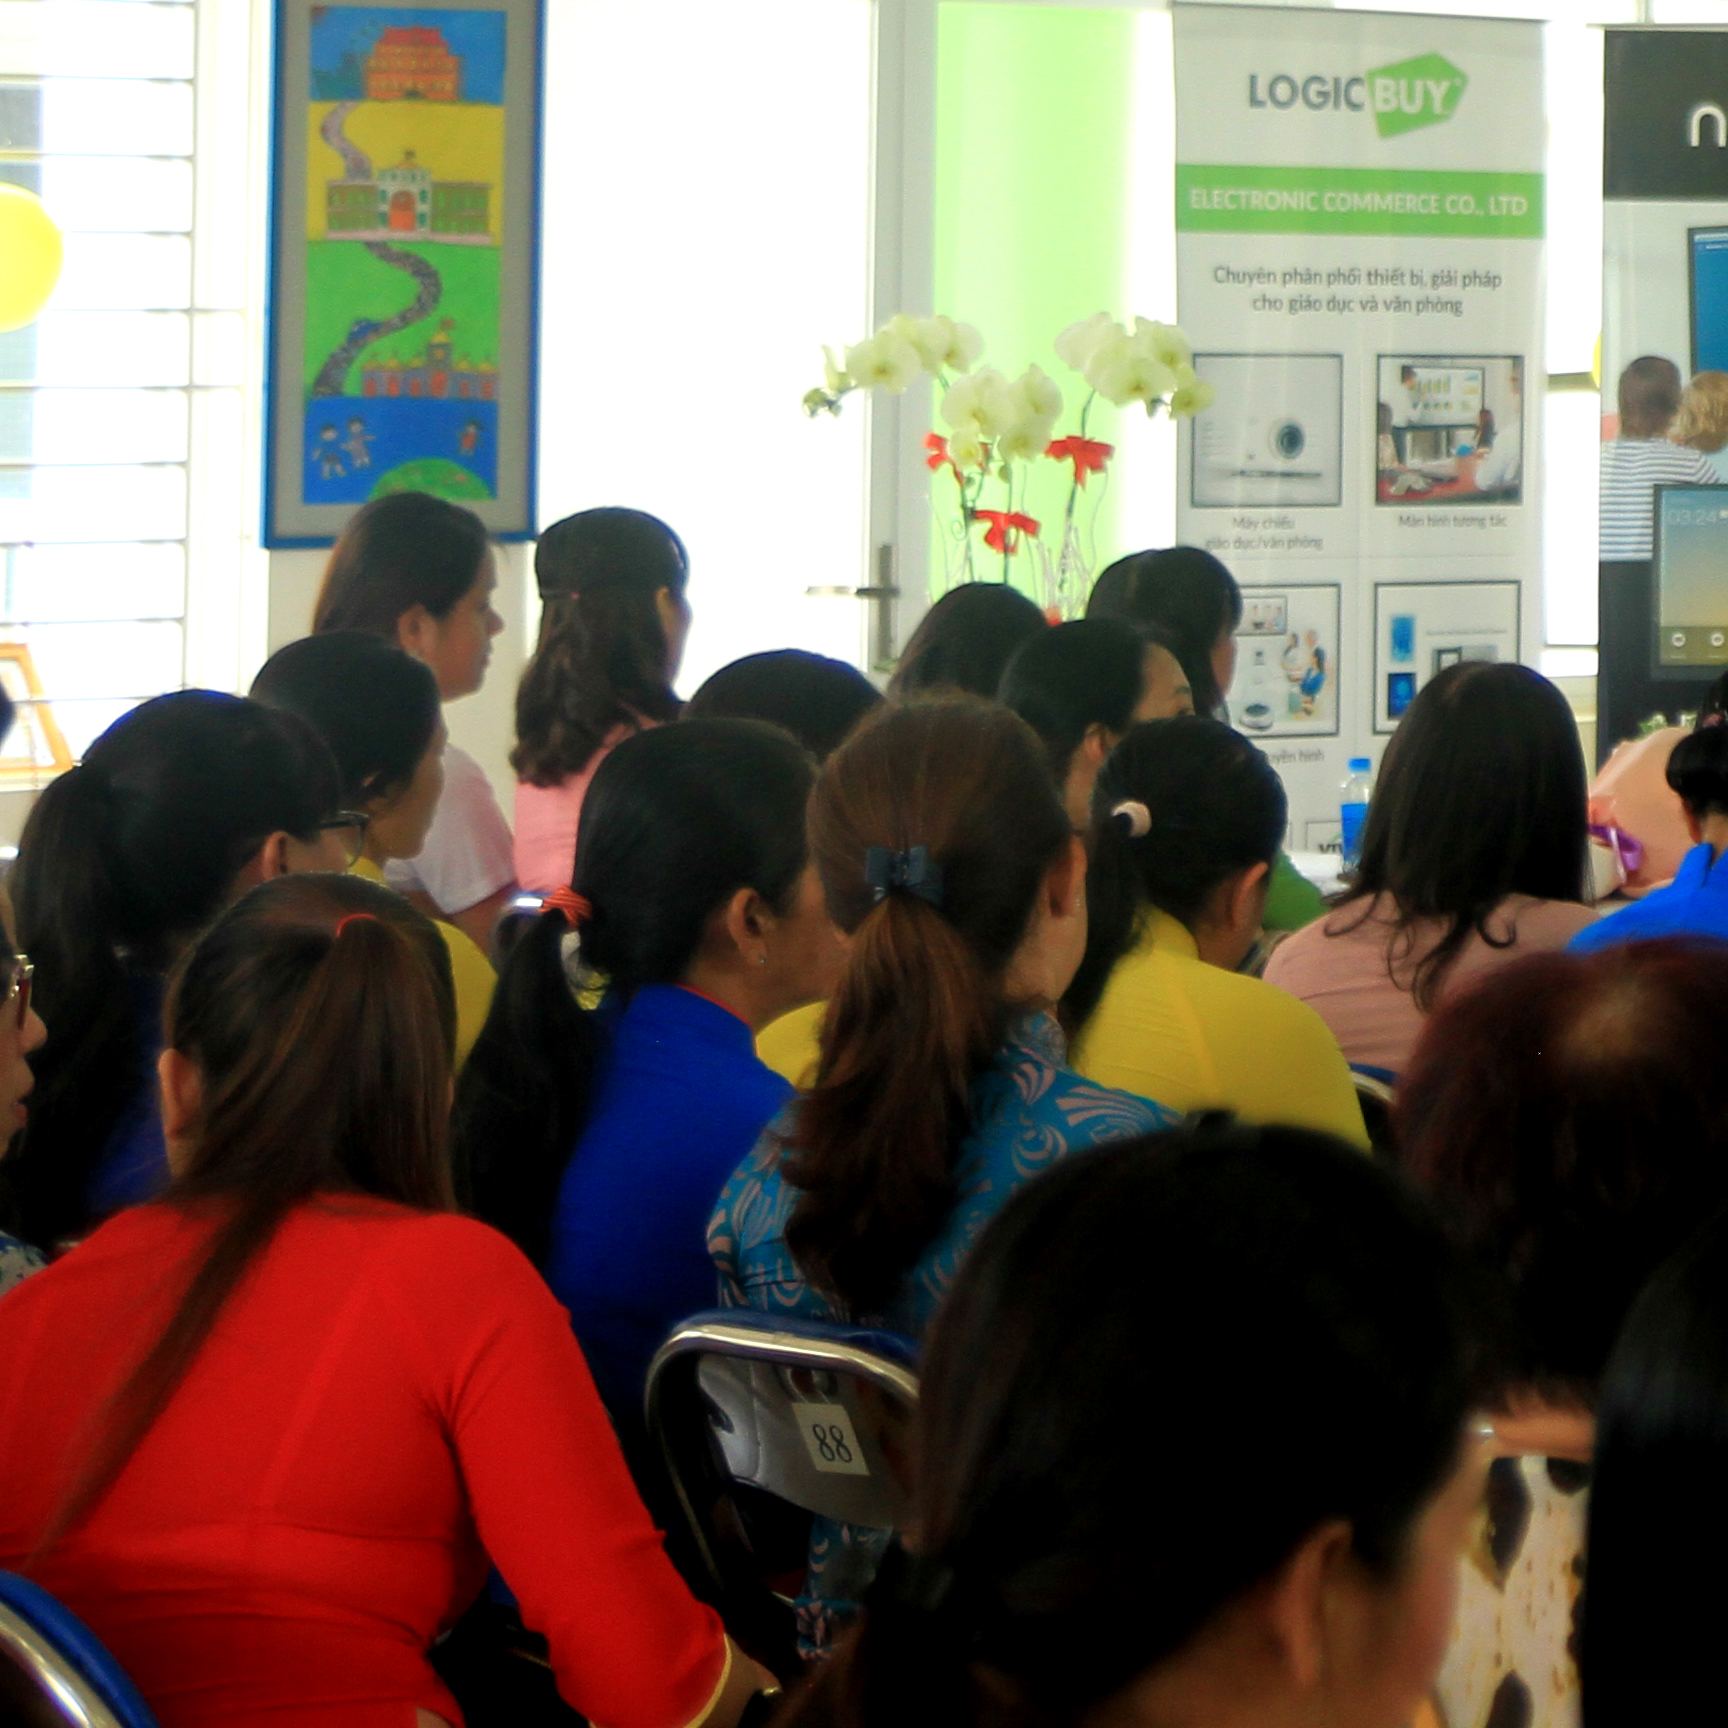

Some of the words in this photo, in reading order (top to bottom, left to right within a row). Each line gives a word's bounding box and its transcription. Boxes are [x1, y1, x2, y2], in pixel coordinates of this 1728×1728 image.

[1189, 188, 1320, 213] ELECTRONIC
[1323, 191, 1440, 215] COMMERCE
[1489, 195, 1528, 217] LTD
[1214, 265, 1277, 289] Chuyên
[1282, 267, 1323, 288] phân
[1327, 267, 1361, 289] phối
[1366, 268, 1405, 287] thiết
[1431, 269, 1459, 291] giải
[1462, 270, 1502, 292] pháp
[1252, 293, 1283, 313] cho
[1288, 294, 1323, 315] giáo
[1326, 294, 1355, 316] dục
[1359, 294, 1379, 312] và
[1383, 295, 1412, 313] văn
[1416, 295, 1464, 318] phòng
[812, 1423, 853, 1463] 88
